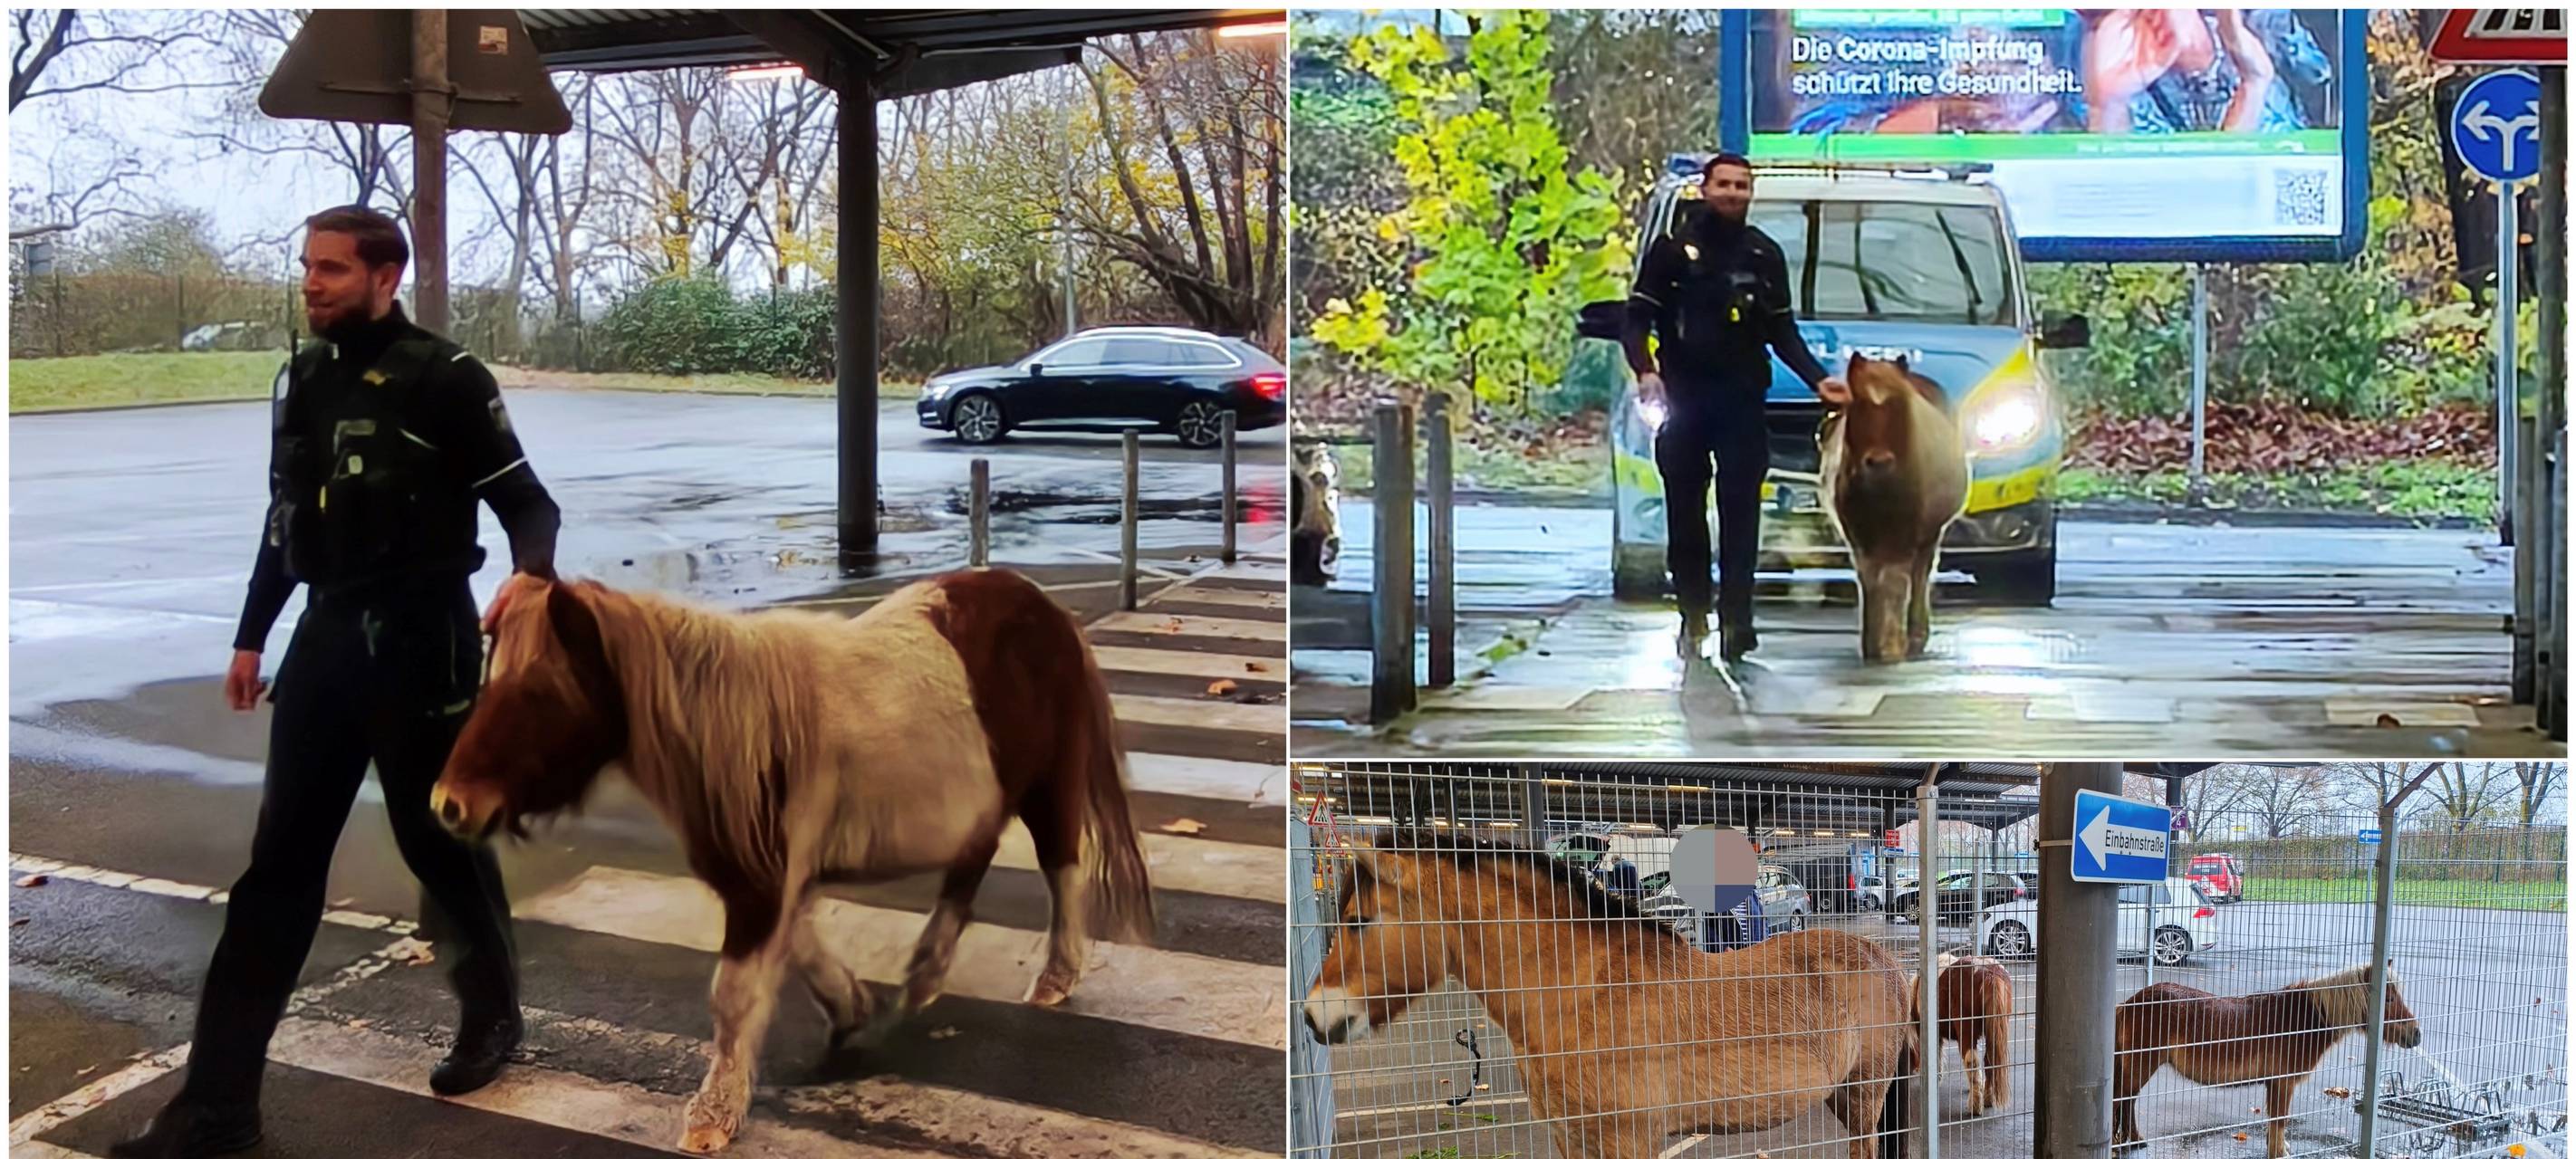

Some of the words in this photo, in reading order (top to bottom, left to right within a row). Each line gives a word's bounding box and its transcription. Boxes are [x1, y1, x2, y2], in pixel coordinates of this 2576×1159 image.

[1793, 37, 1831, 62] Die
[1837, 36, 2044, 65] Corona-Impfung
[1793, 69, 1881, 95] schützt
[1887, 69, 1934, 95] Ihre
[1937, 69, 2082, 94] Gesundheit.
[2105, 829, 2164, 853] Einbahnstraße
